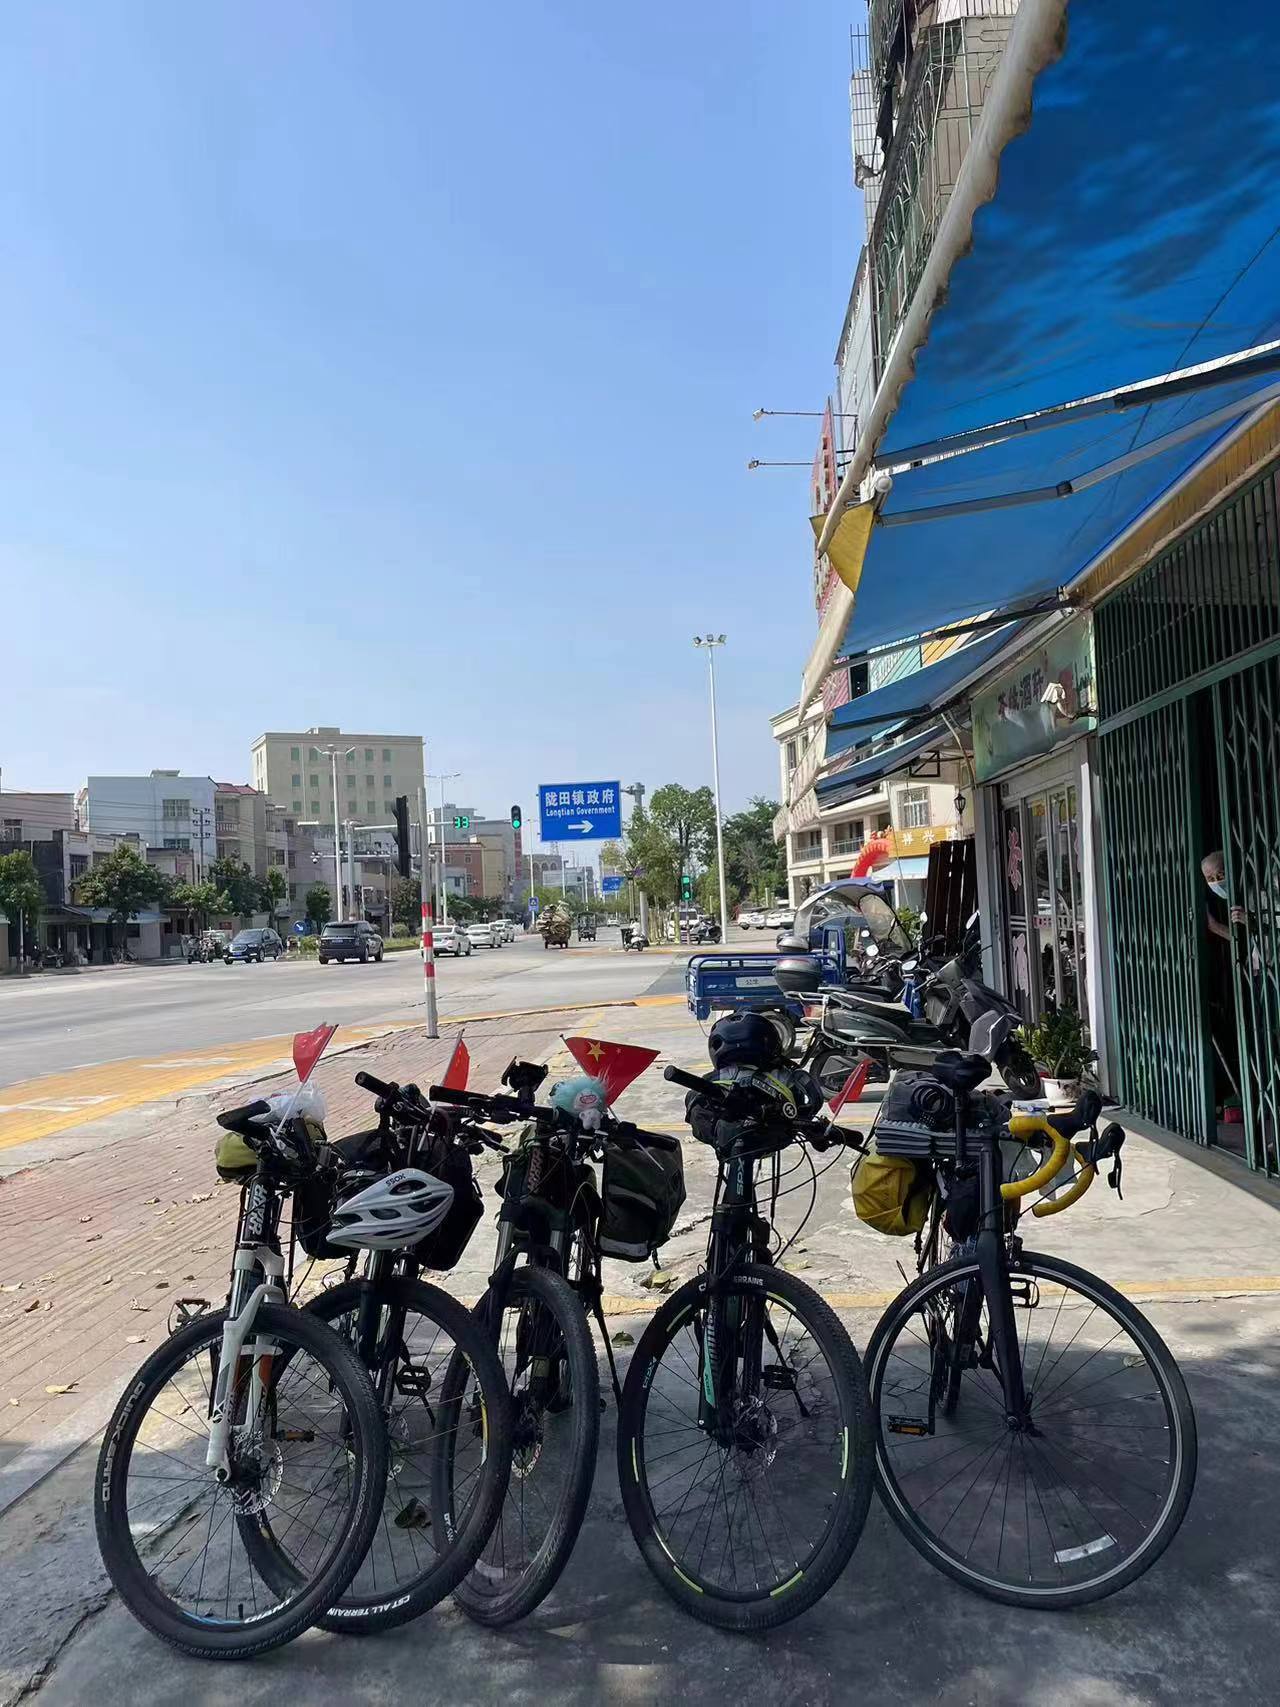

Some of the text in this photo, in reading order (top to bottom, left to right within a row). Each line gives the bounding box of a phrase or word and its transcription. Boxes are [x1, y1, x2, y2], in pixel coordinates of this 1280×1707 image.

[545, 789, 614, 807] 陇田镇政府
[546, 806, 615, 818] Longtian Government
[385, 1173, 406, 1187] XOSS
[372, 1603, 391, 1614] ALL
[391, 1594, 411, 1609] CST
